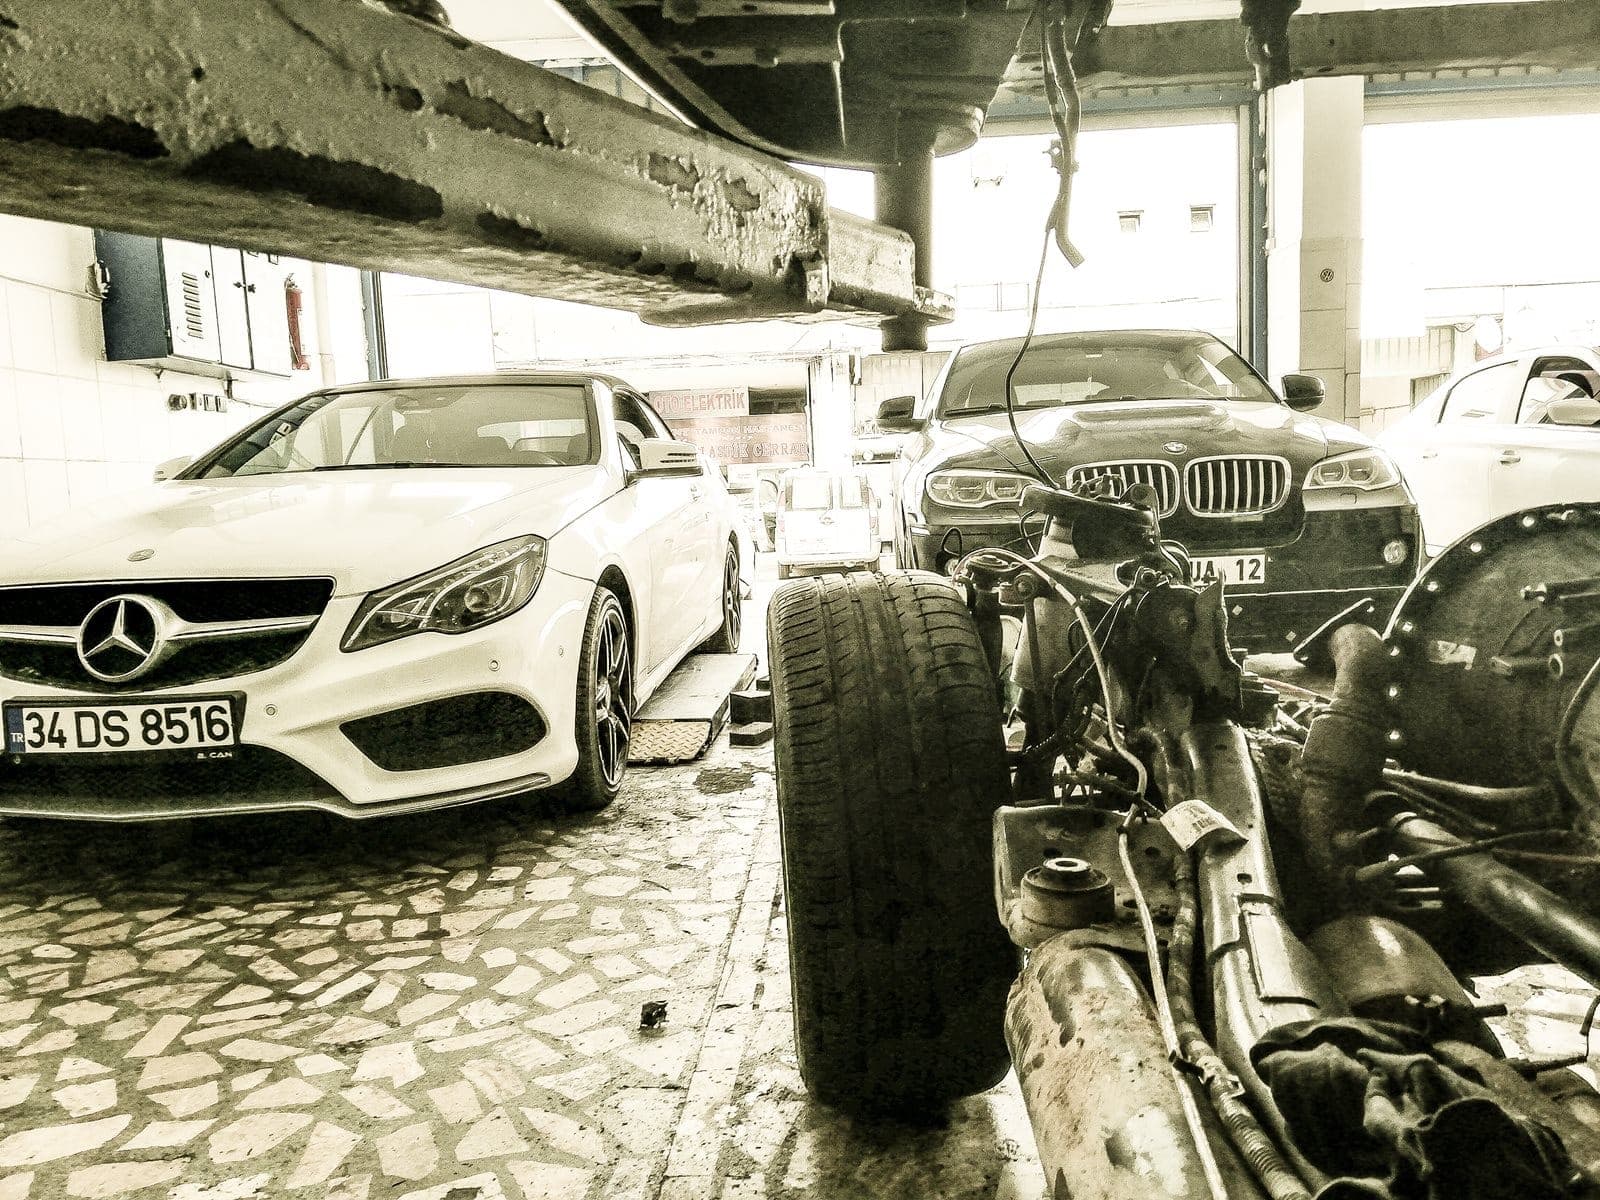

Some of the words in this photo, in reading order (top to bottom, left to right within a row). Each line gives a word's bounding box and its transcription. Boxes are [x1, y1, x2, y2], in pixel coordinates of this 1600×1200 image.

[653, 394, 680, 414] OTO
[683, 389, 745, 412] ELEKTRİK
[1236, 558, 1261, 581] 12
[11, 733, 25, 743] TR
[25, 711, 67, 749] 34
[74, 710, 130, 748] DS
[140, 705, 230, 746] 8516
